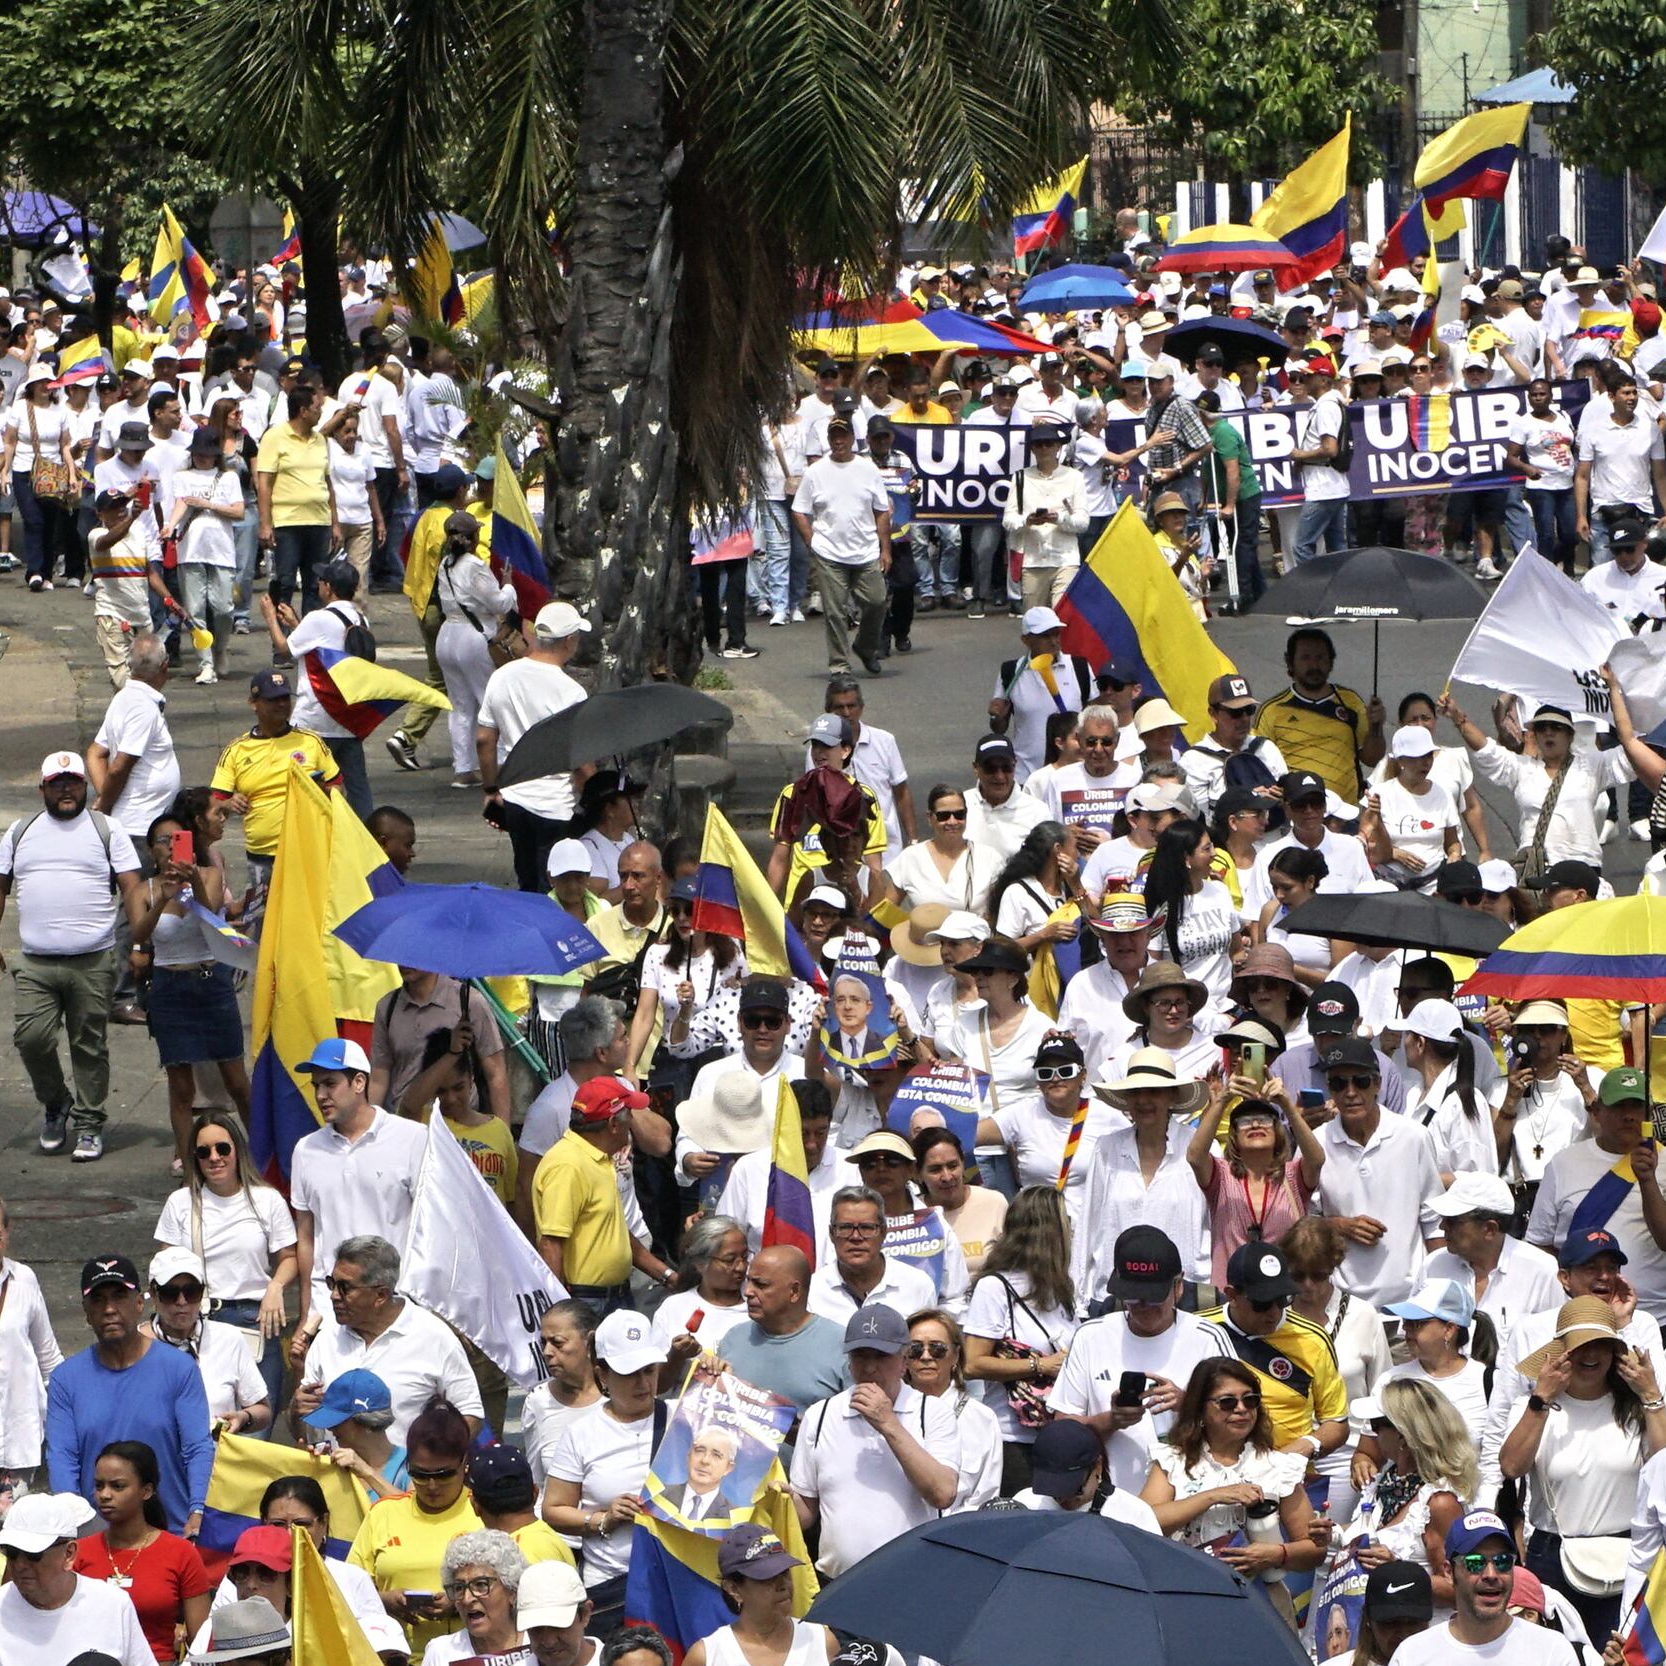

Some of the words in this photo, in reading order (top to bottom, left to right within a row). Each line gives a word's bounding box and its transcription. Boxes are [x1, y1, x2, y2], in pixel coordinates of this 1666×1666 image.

[916, 429, 1028, 477] URI
[1084, 789, 1114, 801] URIBE
[1071, 800, 1125, 813] COLOMBIA
[1088, 810, 1114, 825] CONT
[930, 1065, 965, 1079] URIBE
[911, 1077, 972, 1095] COLOMBIA
[897, 1089, 923, 1103] ESTA
[886, 1213, 915, 1229] RIBE
[885, 1226, 929, 1243] OMBIA
[862, 1316, 878, 1335] ck
